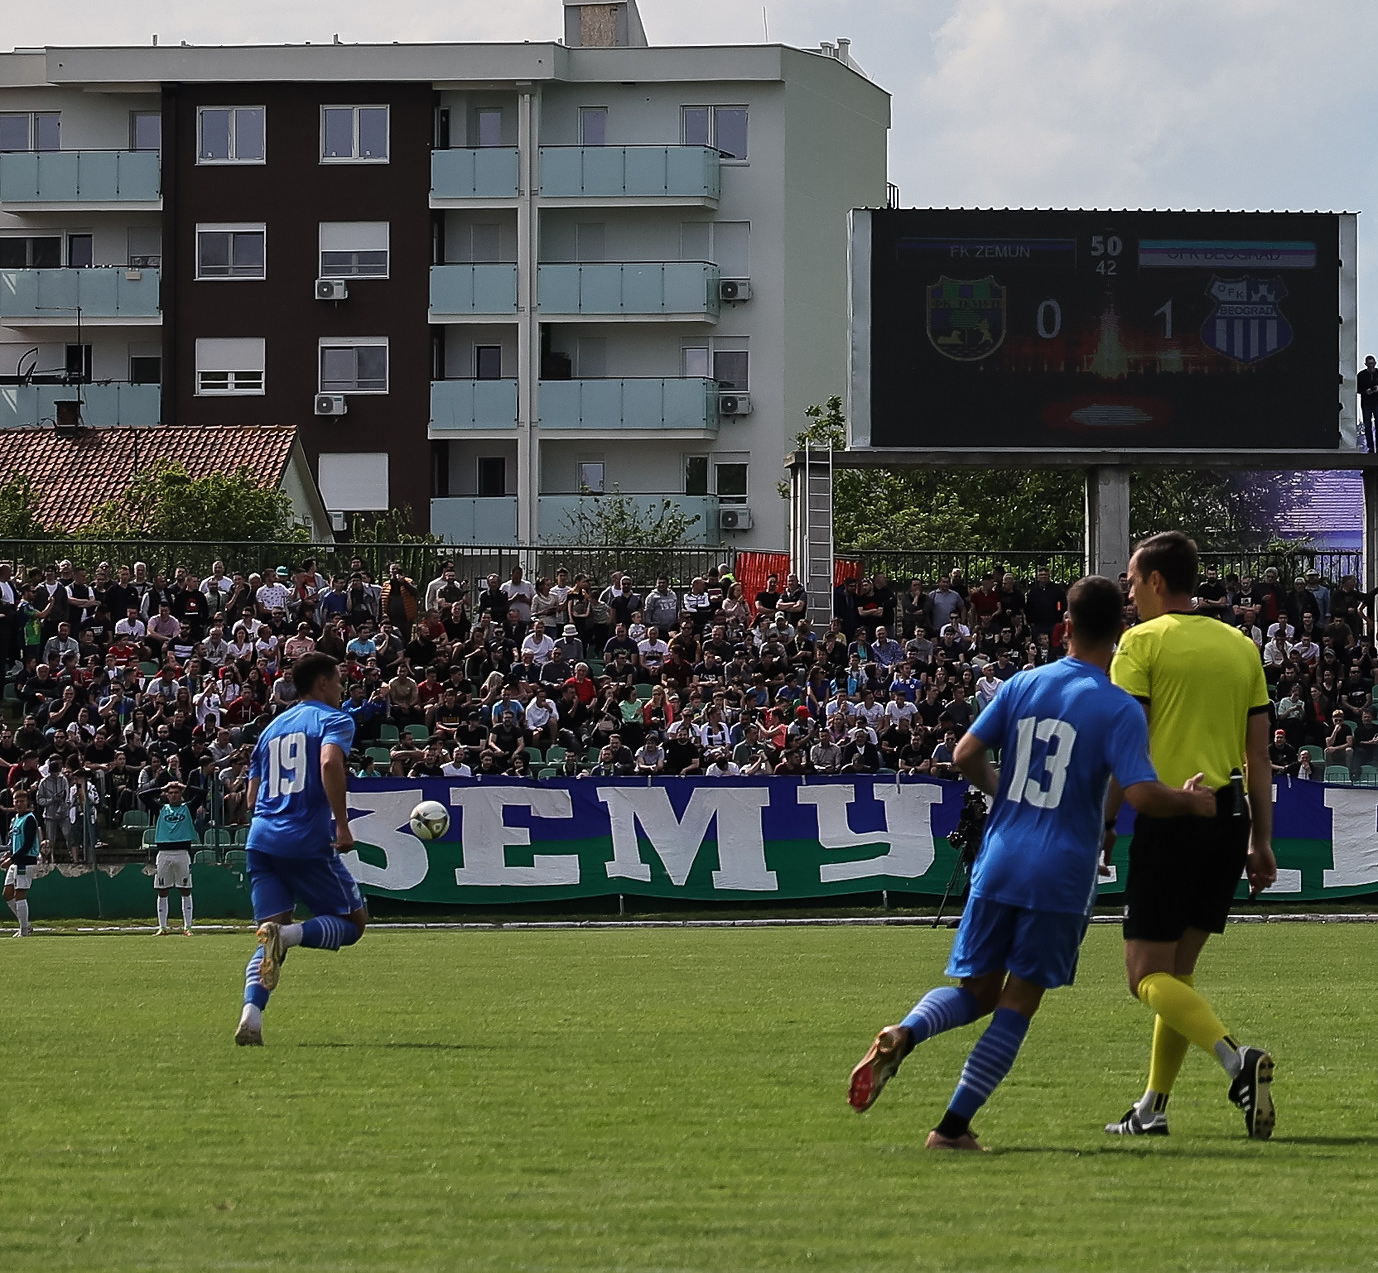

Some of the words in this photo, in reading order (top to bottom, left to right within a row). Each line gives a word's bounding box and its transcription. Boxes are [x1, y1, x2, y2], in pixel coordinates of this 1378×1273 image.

[951, 245, 970, 258] FK
[976, 245, 1031, 259] ZEMUN
[1090, 235, 1123, 257] 50
[1095, 260, 1118, 276] 42
[1036, 298, 1062, 340] 0
[1153, 298, 1174, 340] 1
[1220, 305, 1275, 316] BEOGRAD
[268, 732, 307, 799] 19
[1007, 716, 1077, 809] 13
